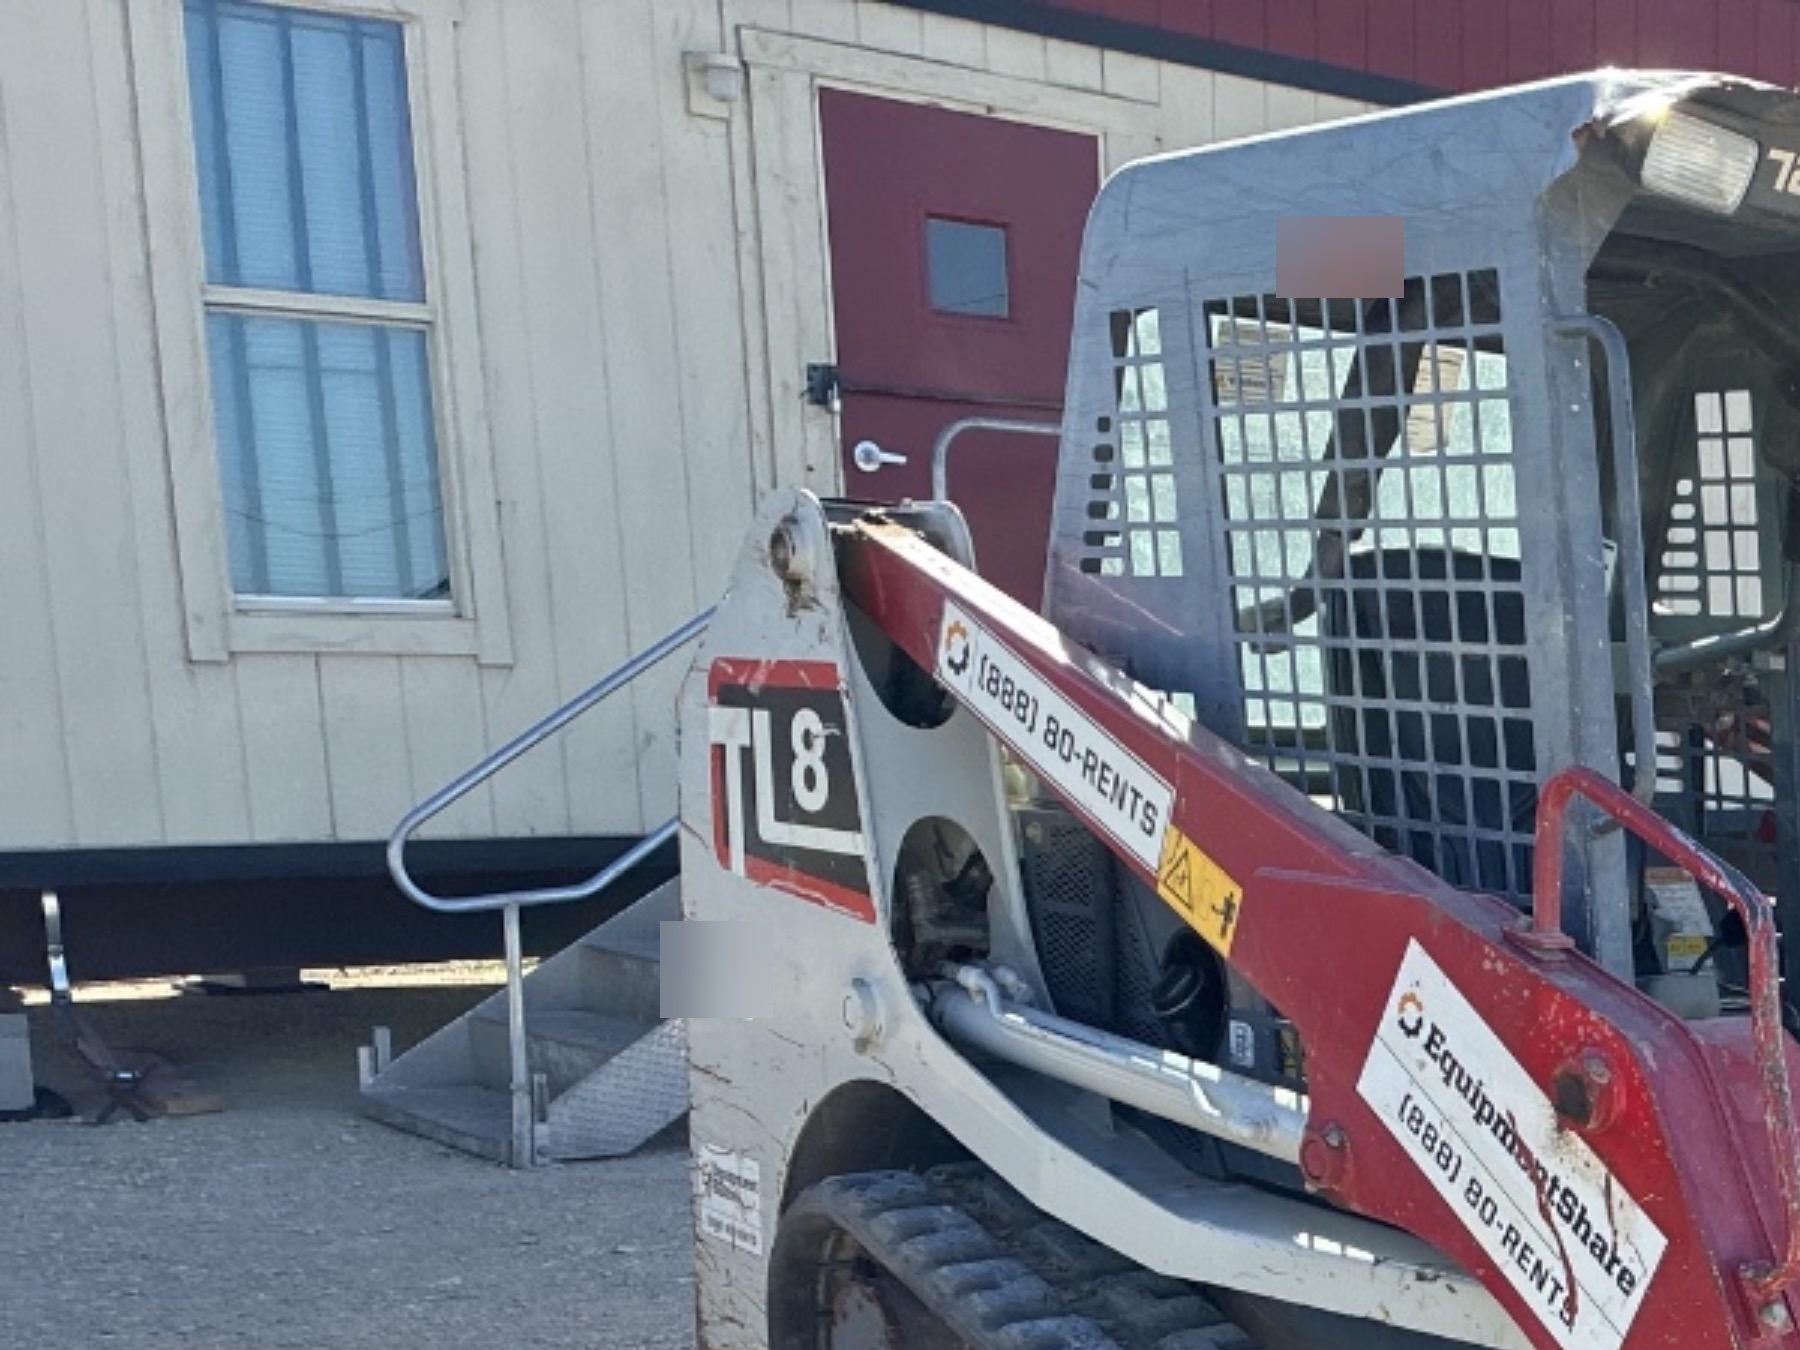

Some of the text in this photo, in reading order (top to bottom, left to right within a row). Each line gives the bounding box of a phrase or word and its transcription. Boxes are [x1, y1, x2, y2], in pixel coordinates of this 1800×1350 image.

[978, 656, 1160, 838] (888) 80-RENTS
[1398, 1093, 1577, 1333] (888) 80-RENTS
